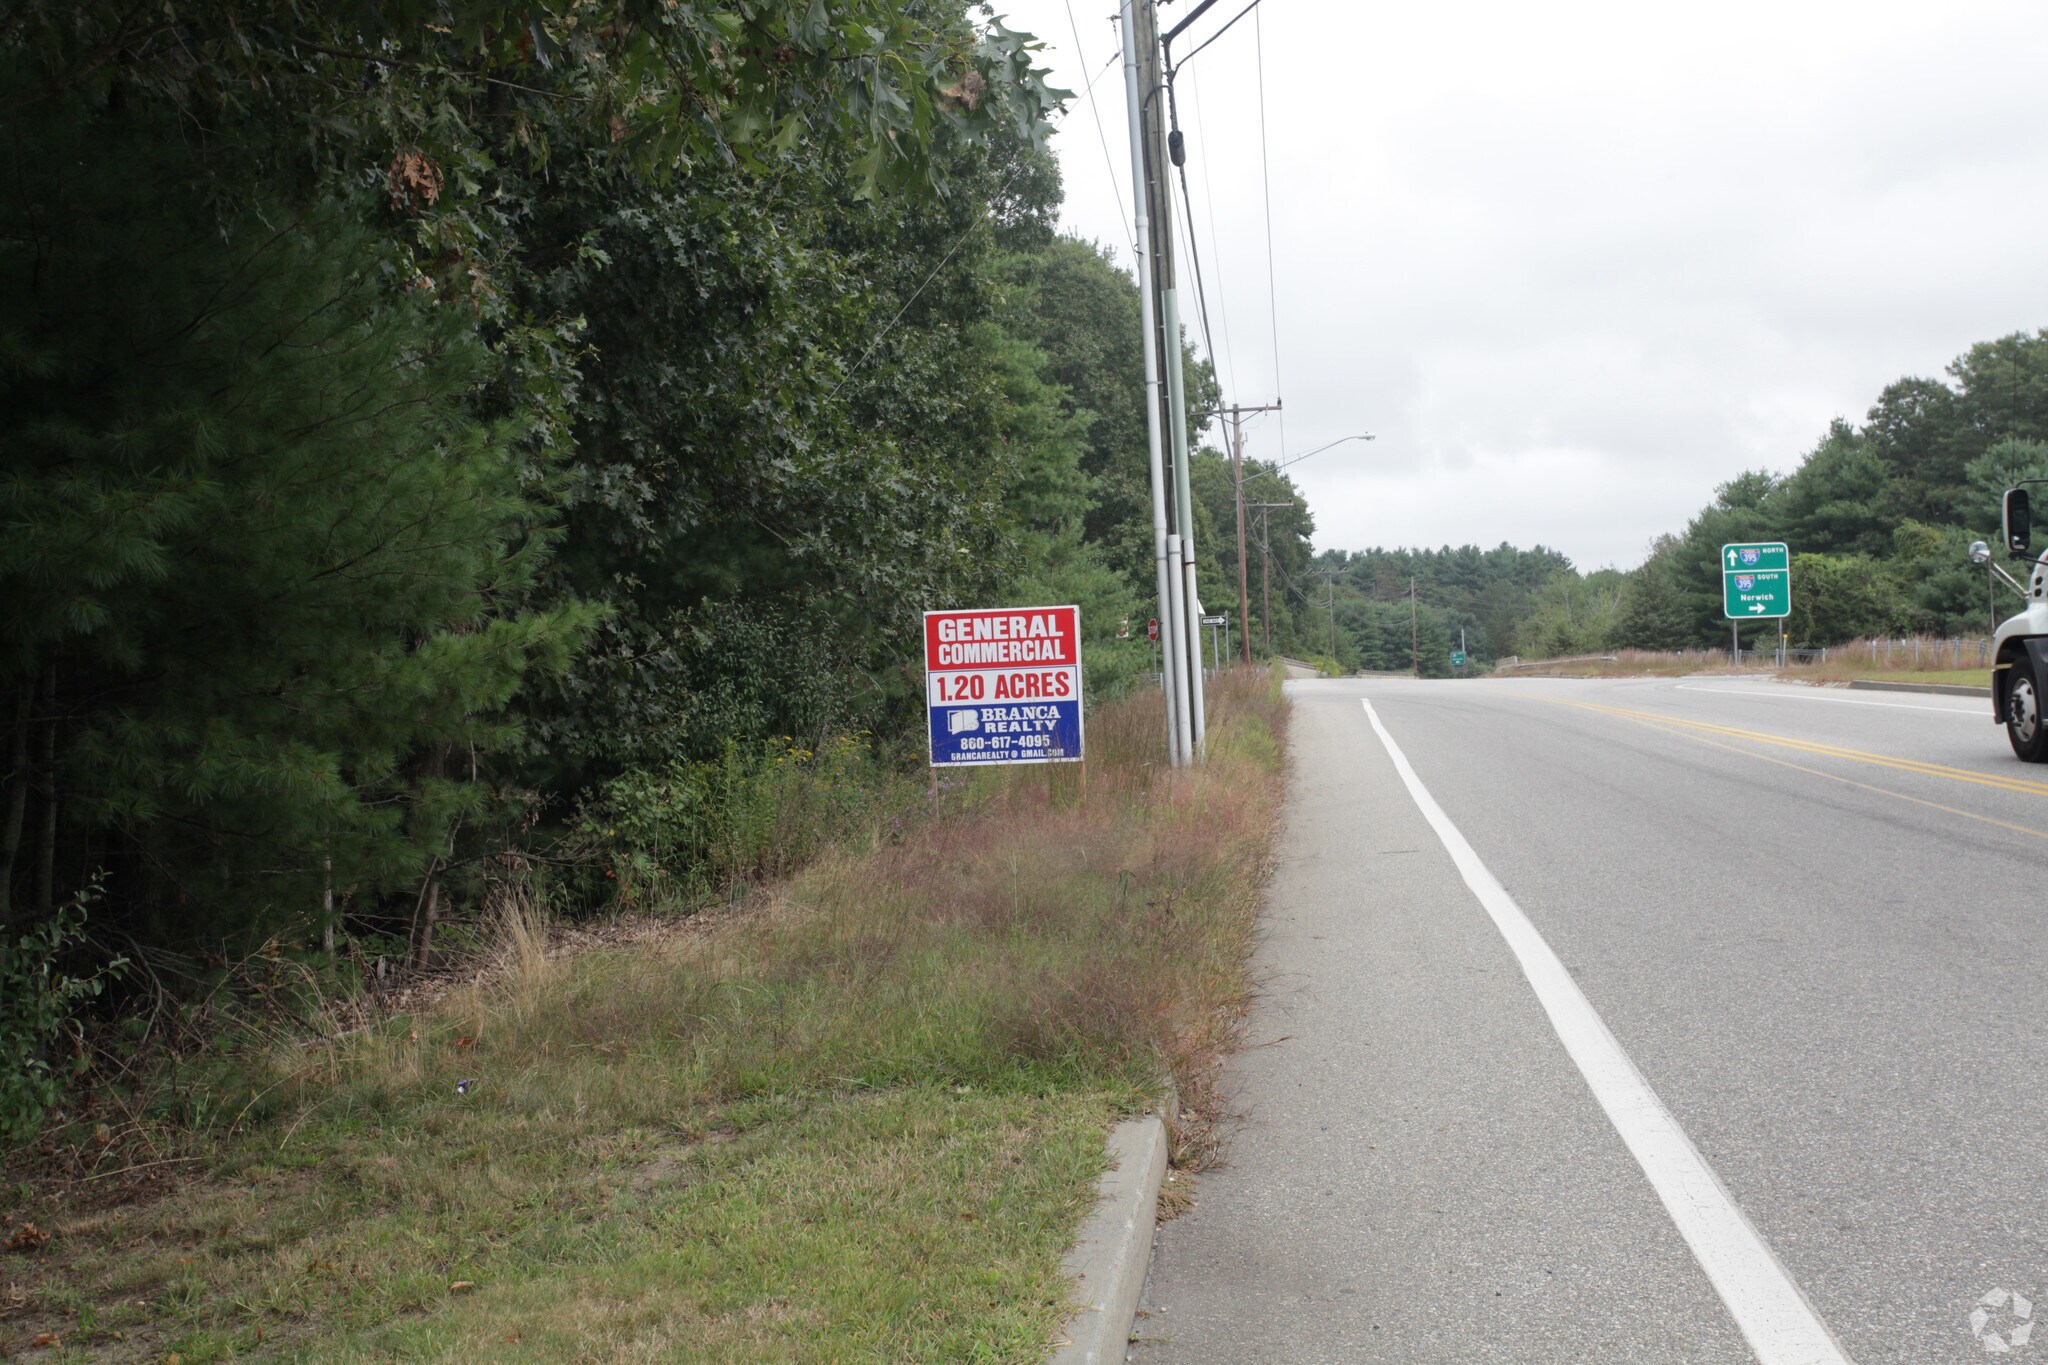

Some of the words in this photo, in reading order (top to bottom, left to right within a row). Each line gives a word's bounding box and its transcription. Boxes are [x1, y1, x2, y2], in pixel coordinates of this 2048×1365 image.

[1743, 553, 1757, 562] 395
[1738, 580, 1752, 588] 395
[938, 615, 1063, 641] GENERAL
[938, 640, 1065, 664] COMMERCIAL
[937, 674, 985, 702] 1.20
[994, 671, 1070, 700] ACRES
[981, 705, 1061, 722] BRANCA
[985, 720, 1058, 734] REALTY
[960, 735, 1050, 750] 860-617-4095
